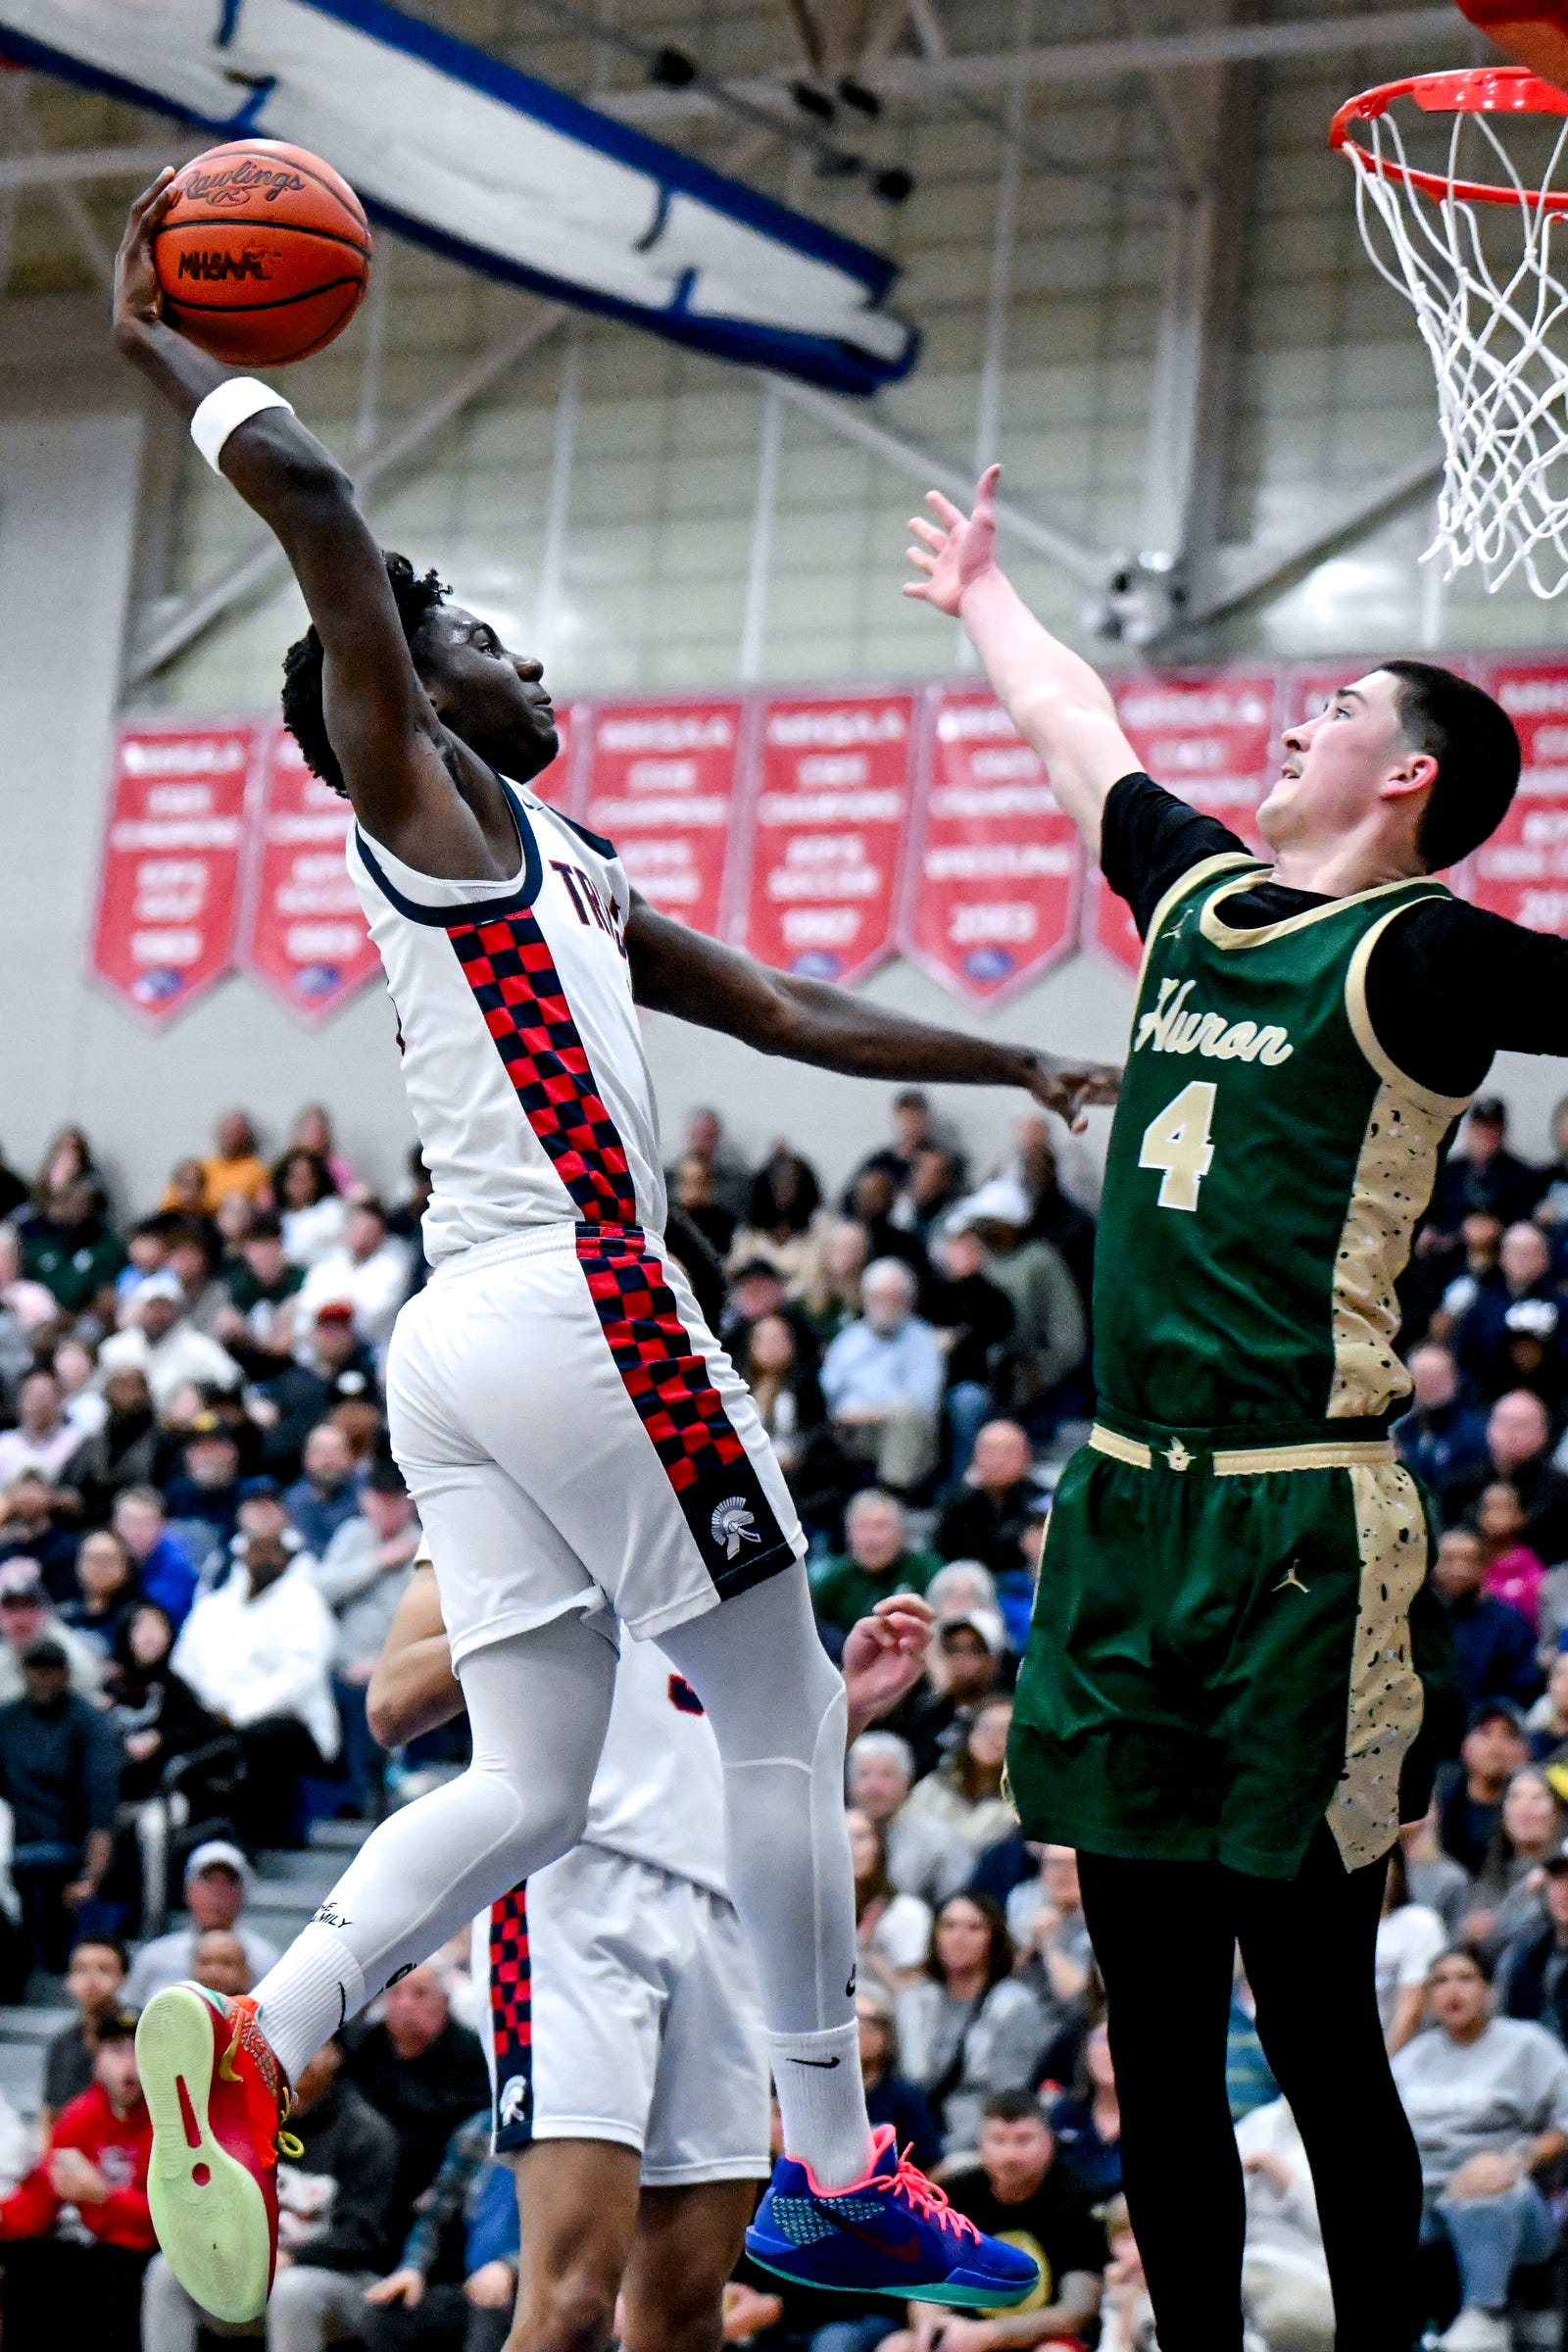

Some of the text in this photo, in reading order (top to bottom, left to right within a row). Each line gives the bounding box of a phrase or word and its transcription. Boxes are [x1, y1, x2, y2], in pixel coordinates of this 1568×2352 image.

[184, 160, 306, 202] Rawlings
[1134, 978, 1294, 1066] Huron
[1138, 1080, 1218, 1212] 4
